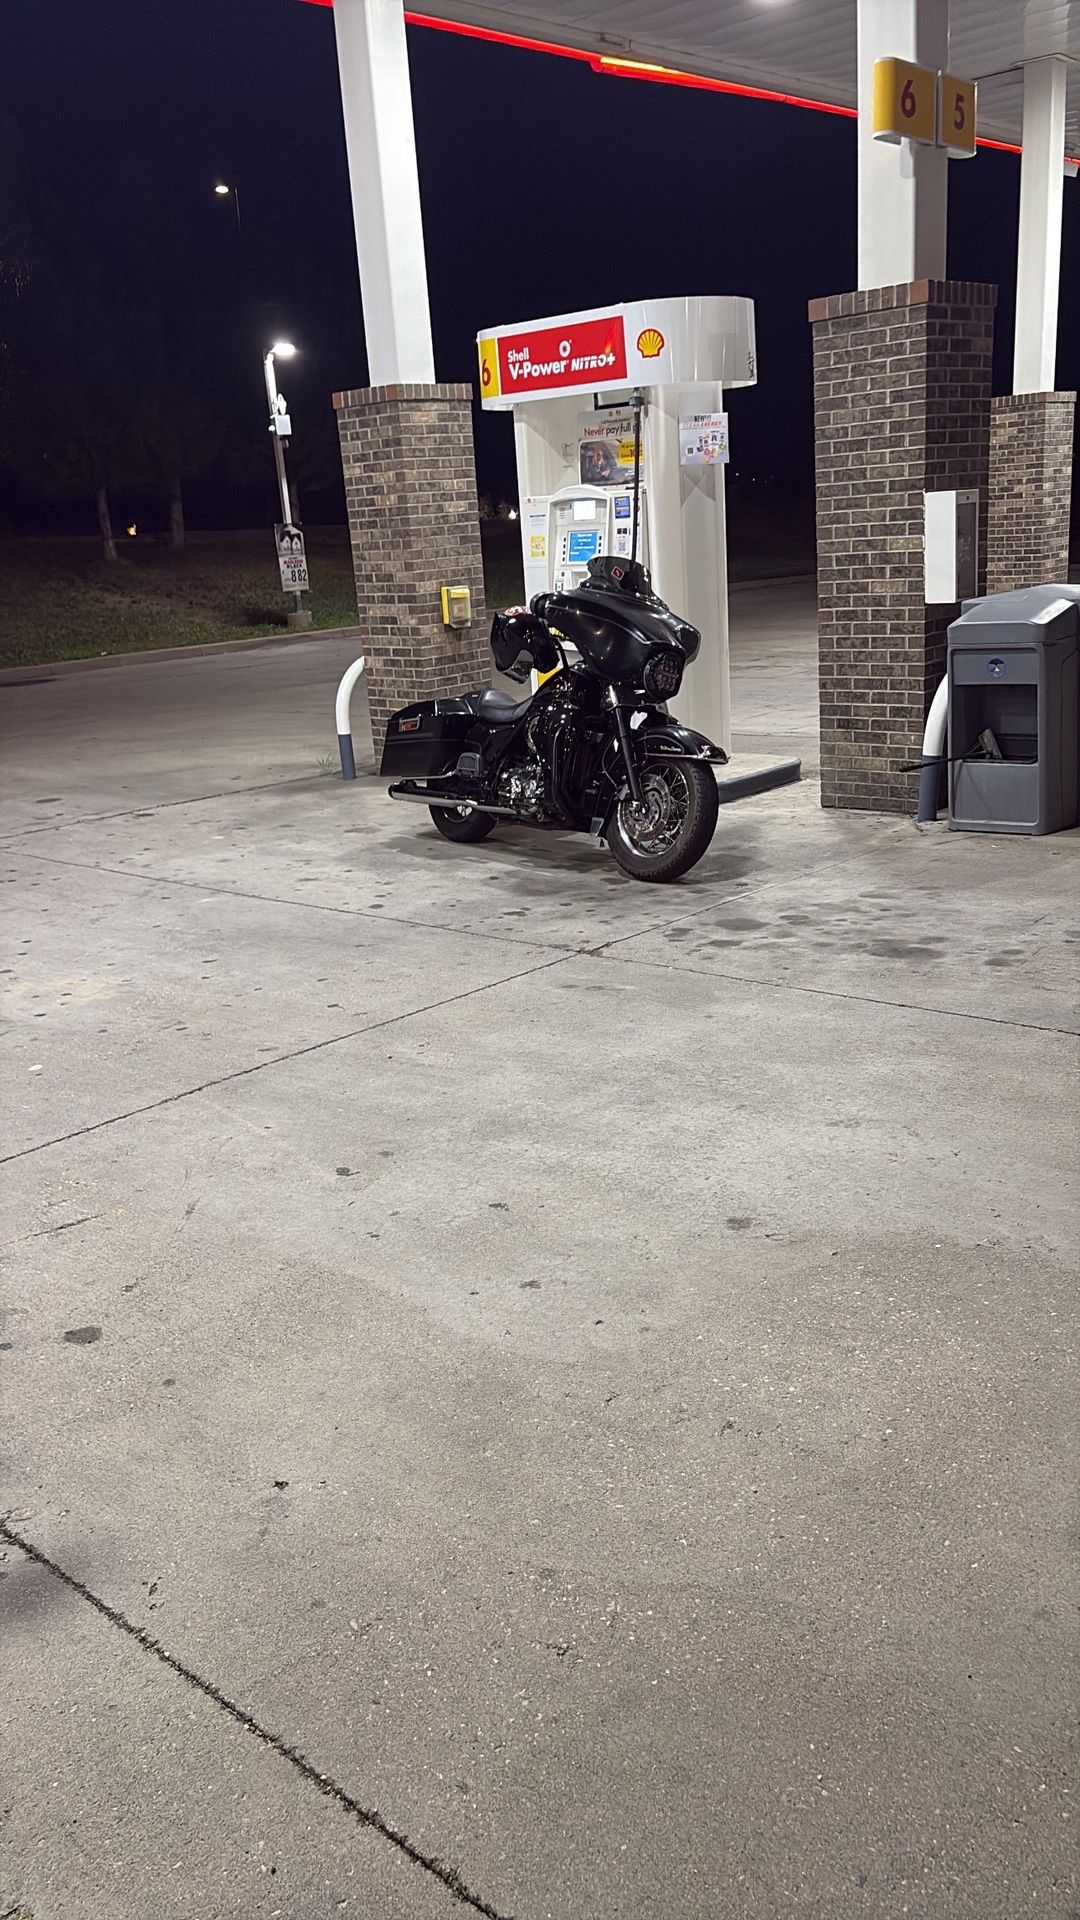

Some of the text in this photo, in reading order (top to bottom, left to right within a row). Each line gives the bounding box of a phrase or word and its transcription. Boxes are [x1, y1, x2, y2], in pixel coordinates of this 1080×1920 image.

[901, 79, 917, 118] 6
[954, 92, 966, 131] 5
[507, 347, 529, 363] Shell
[482, 359, 491, 386] 6
[509, 361, 567, 380] V-Power
[584, 426, 604, 437] Never
[605, 426, 619, 437] pay
[619, 422, 631, 436] full
